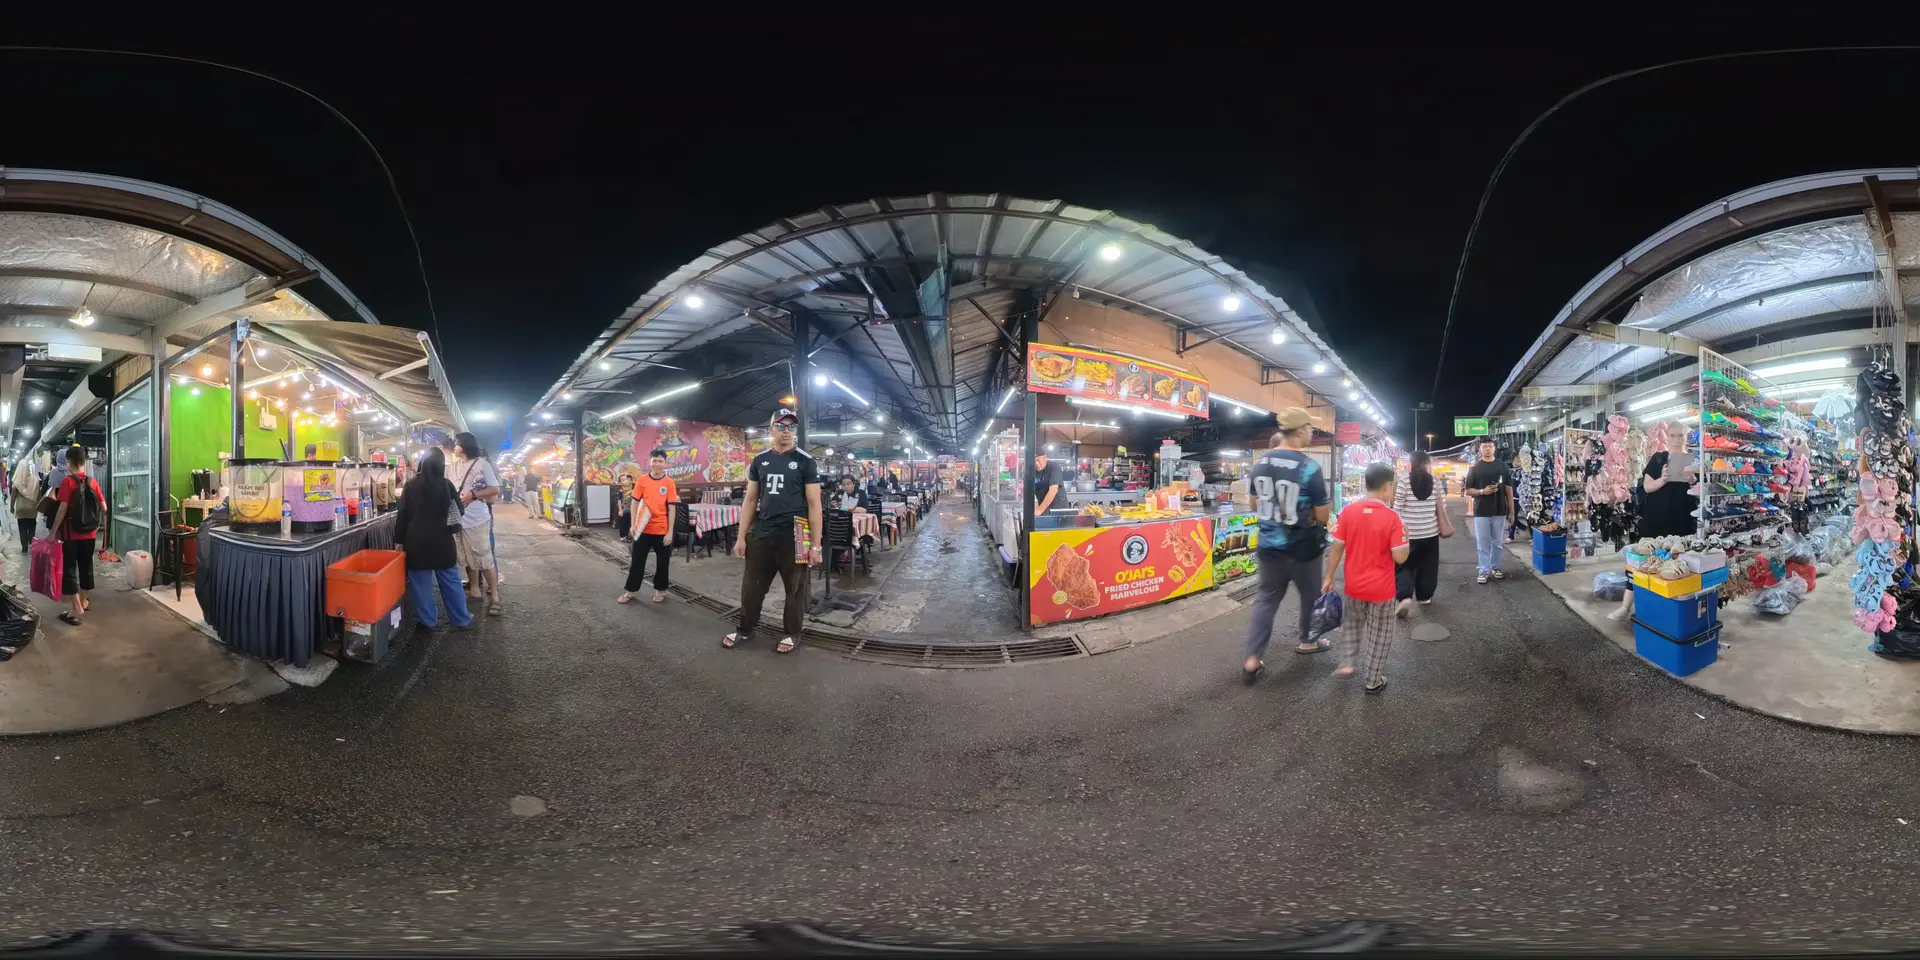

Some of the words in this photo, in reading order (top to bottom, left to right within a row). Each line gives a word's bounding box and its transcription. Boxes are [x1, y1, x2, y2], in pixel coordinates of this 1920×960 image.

[1104, 583, 1130, 594] FRIED
[1130, 576, 1164, 589] CHICKEN
[1110, 584, 1160, 601] MARVELOUS
